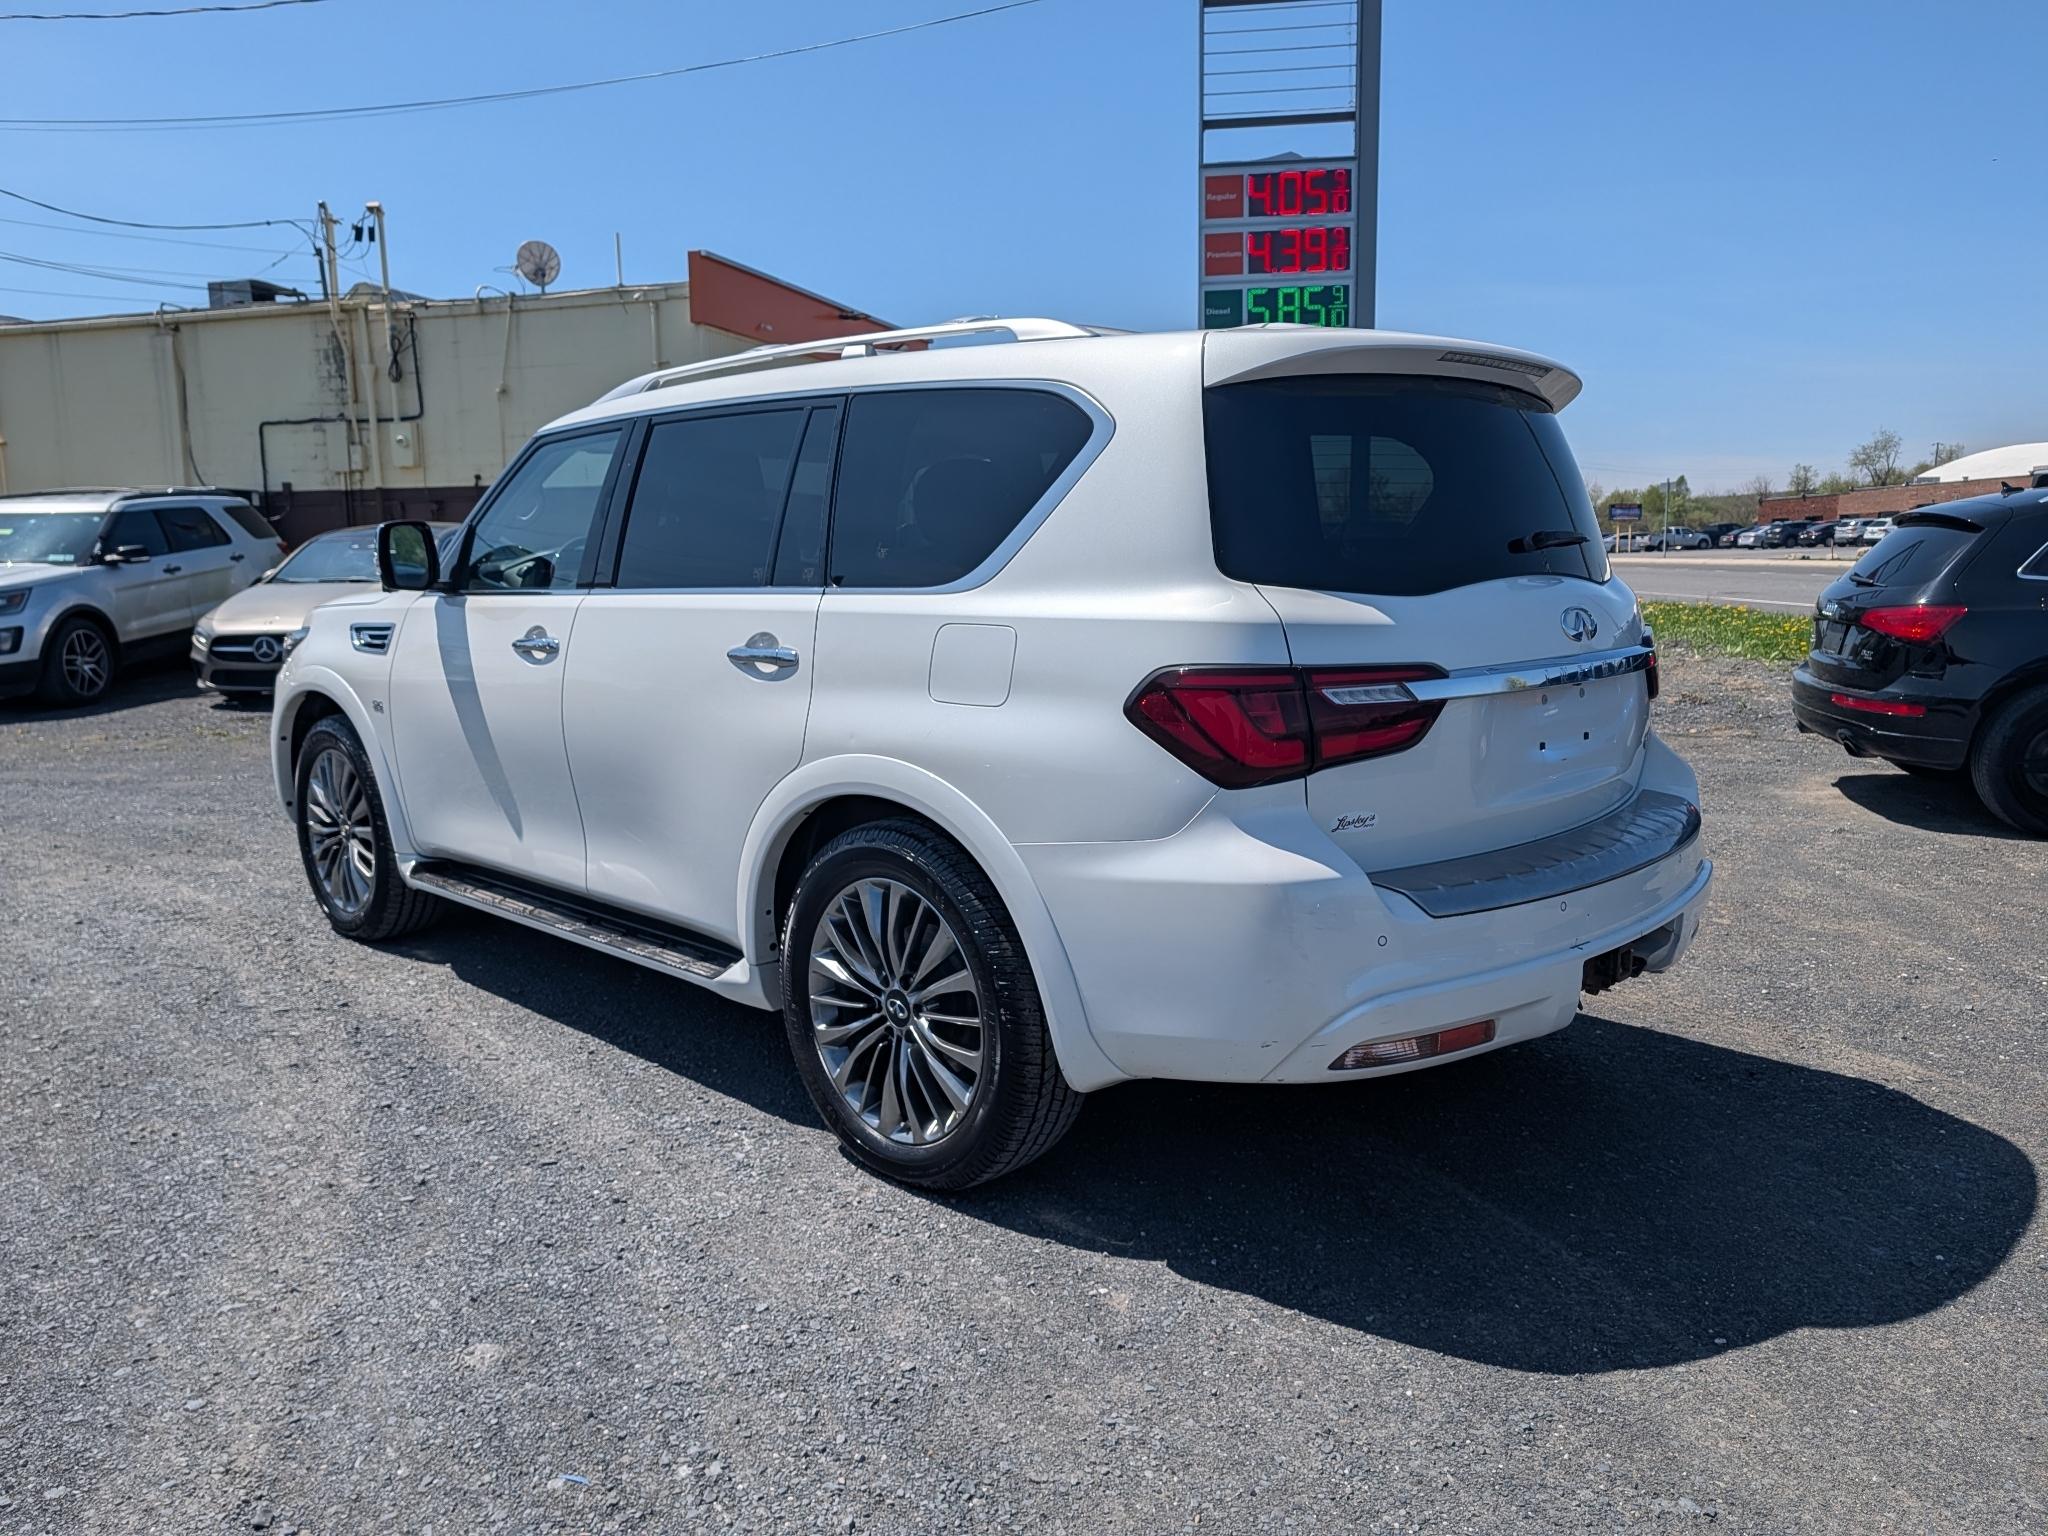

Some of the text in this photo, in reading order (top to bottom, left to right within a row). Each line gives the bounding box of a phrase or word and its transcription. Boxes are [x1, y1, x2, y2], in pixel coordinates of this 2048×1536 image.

[1206, 192, 1237, 203] Regular
[1206, 250, 1241, 259] Premium
[1206, 306, 1232, 316] Diesel
